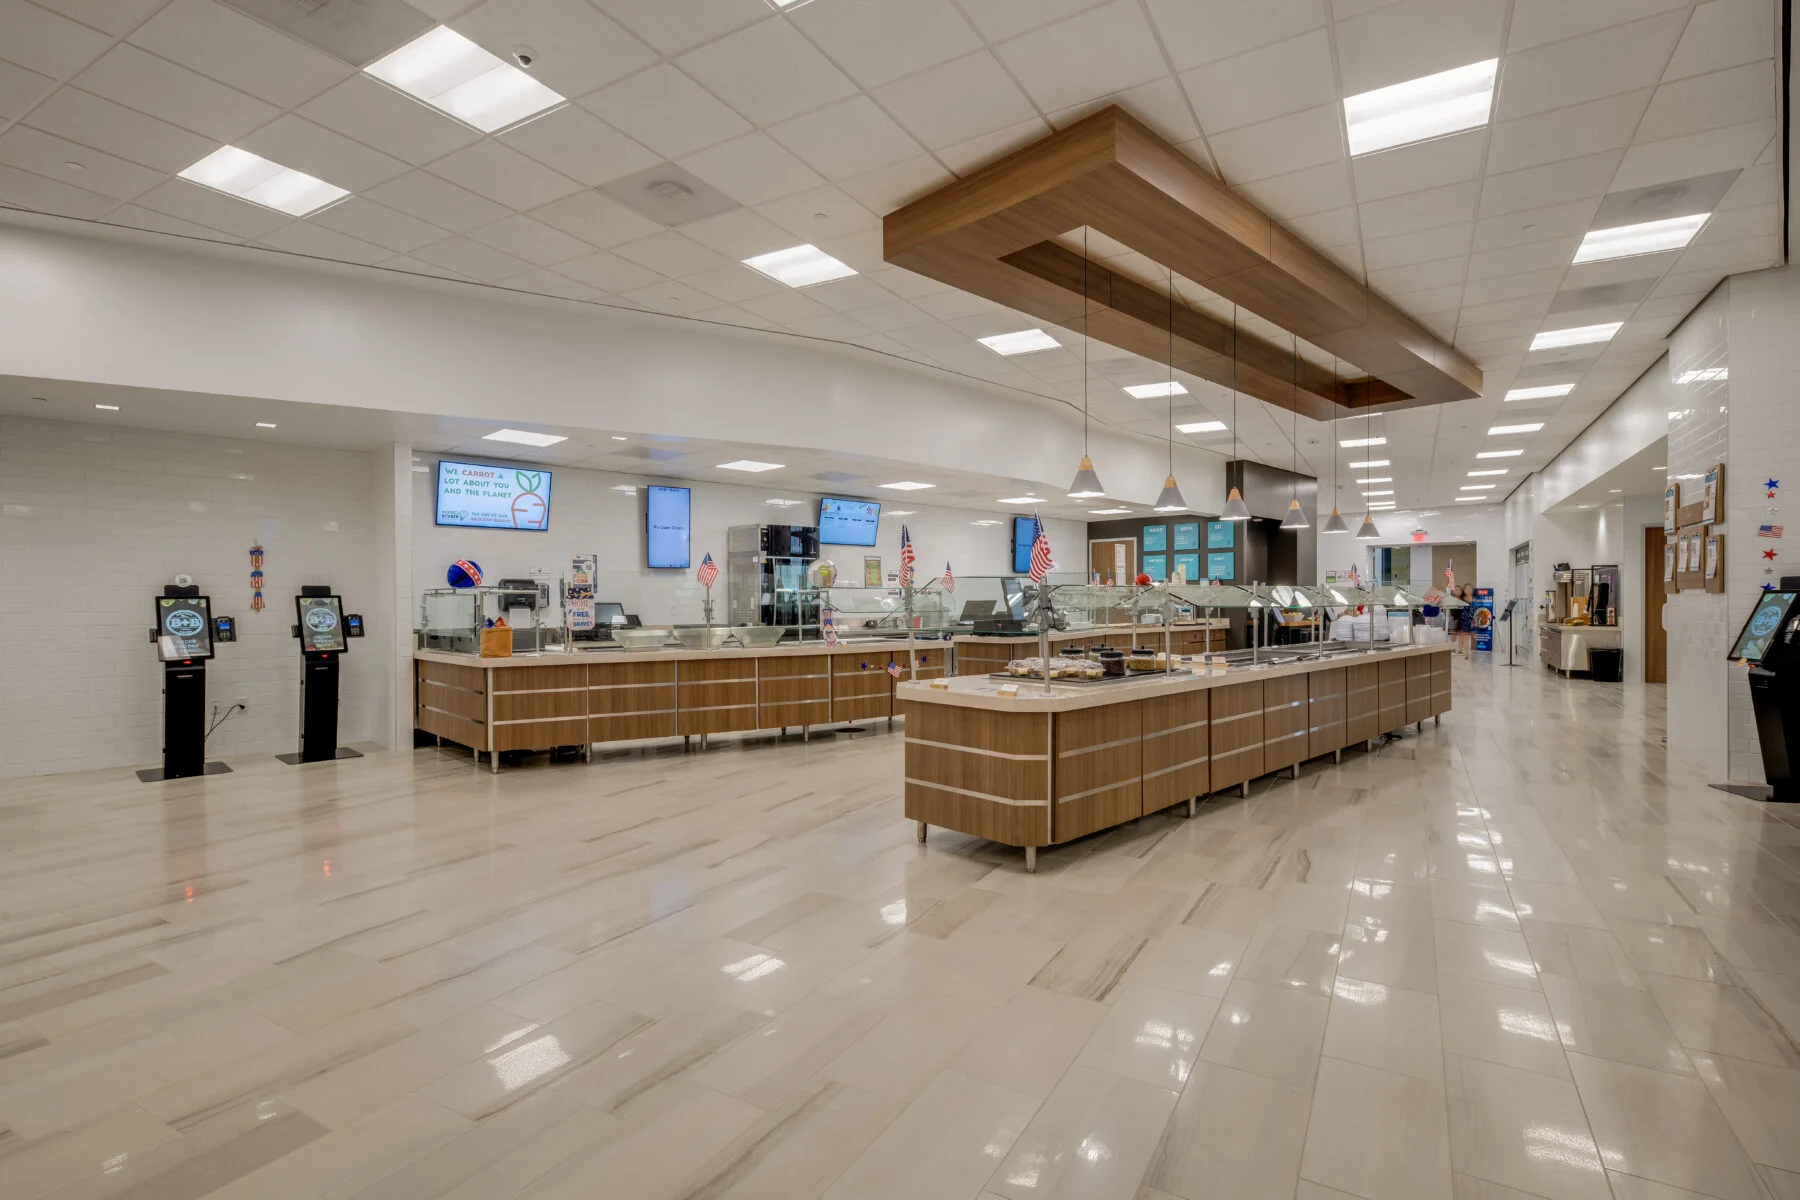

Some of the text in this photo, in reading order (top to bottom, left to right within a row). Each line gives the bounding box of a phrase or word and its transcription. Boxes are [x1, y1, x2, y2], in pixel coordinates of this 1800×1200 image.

[462, 469, 495, 479] CARROT
[463, 479, 491, 487] ABOUT
[444, 487, 462, 495] AND
[171, 617, 201, 629] B+B
